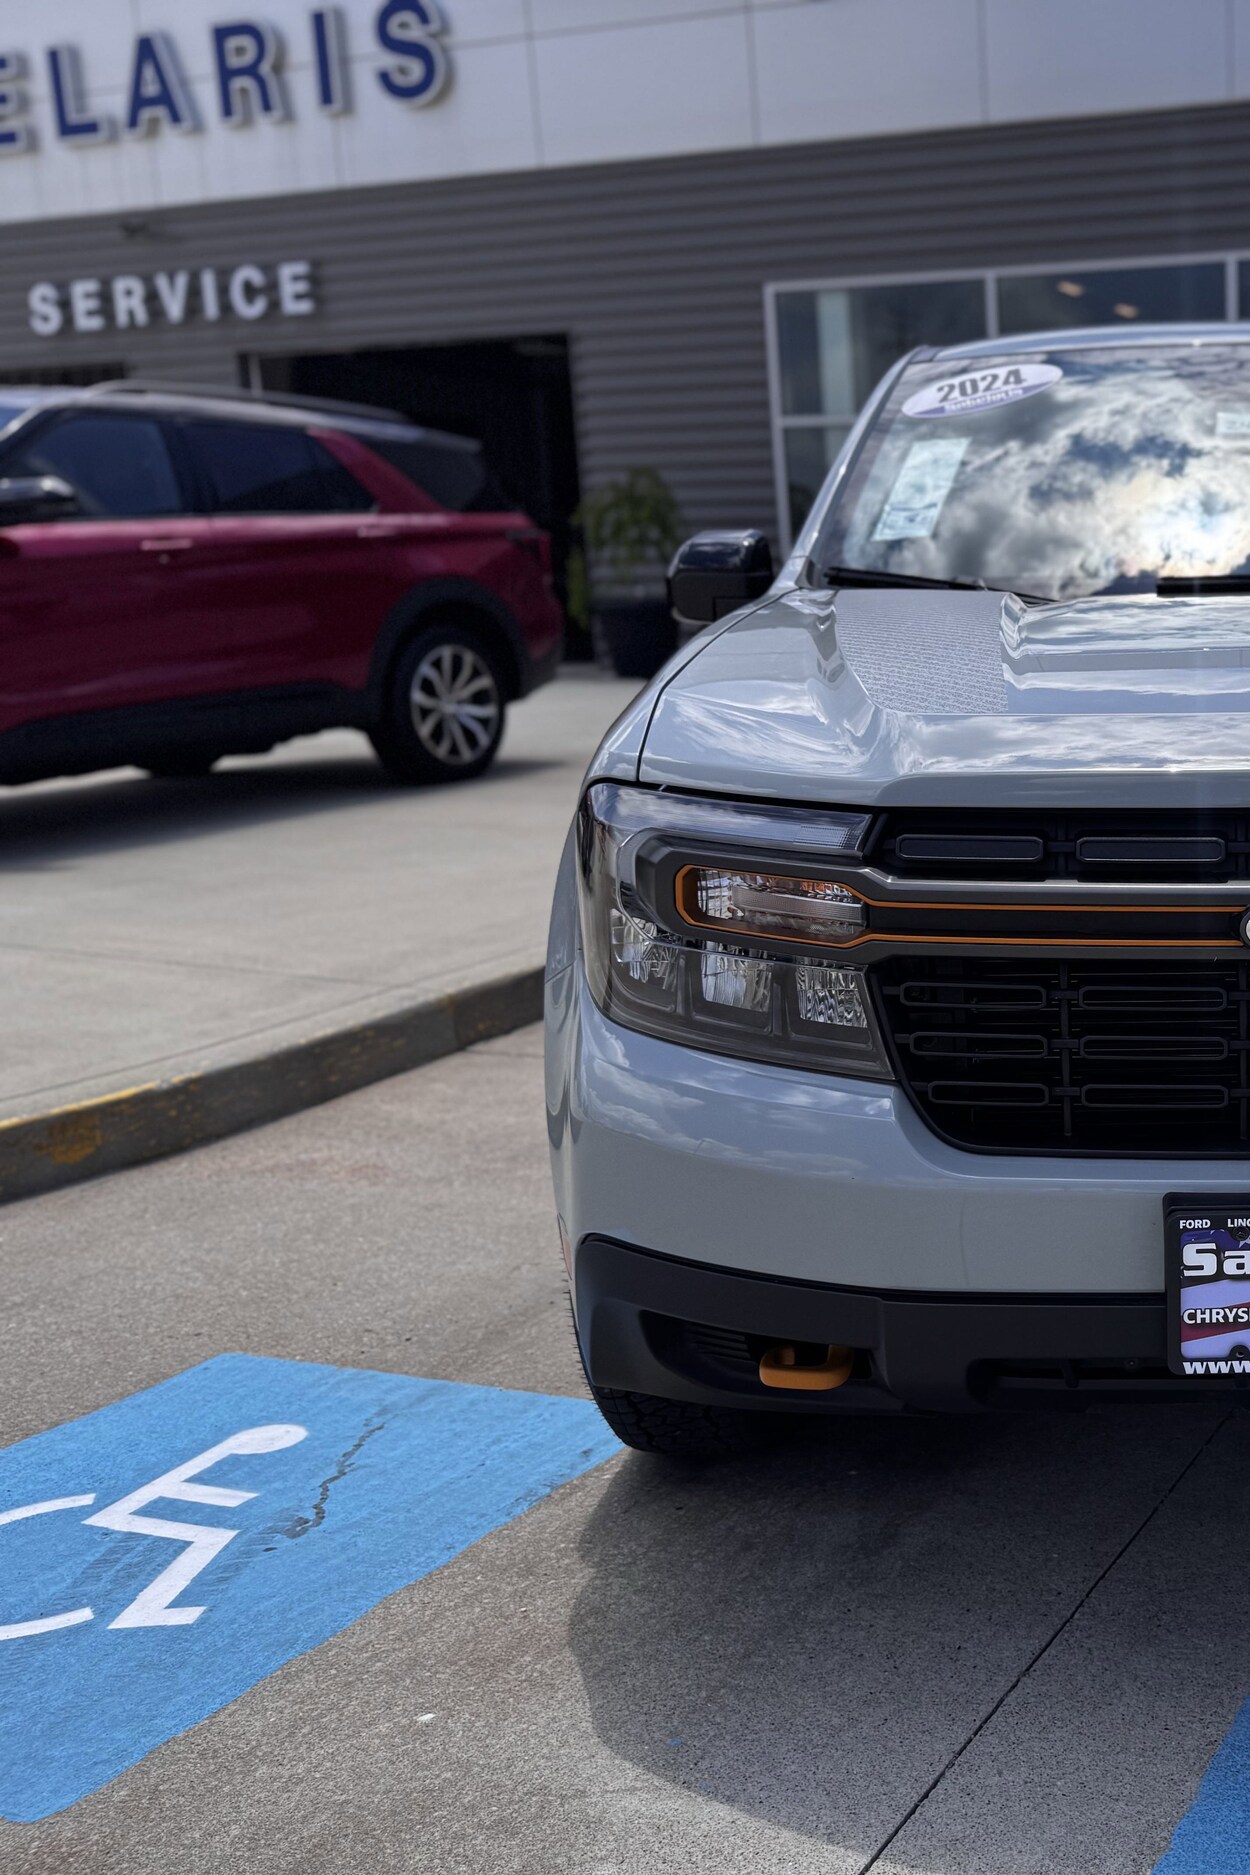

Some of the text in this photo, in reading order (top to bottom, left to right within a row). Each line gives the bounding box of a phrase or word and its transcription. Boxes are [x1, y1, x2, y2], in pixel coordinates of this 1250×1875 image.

[27, 261, 315, 336] SERVICE
[937, 368, 1027, 404] 2024
[1179, 1219, 1211, 1229] FORD
